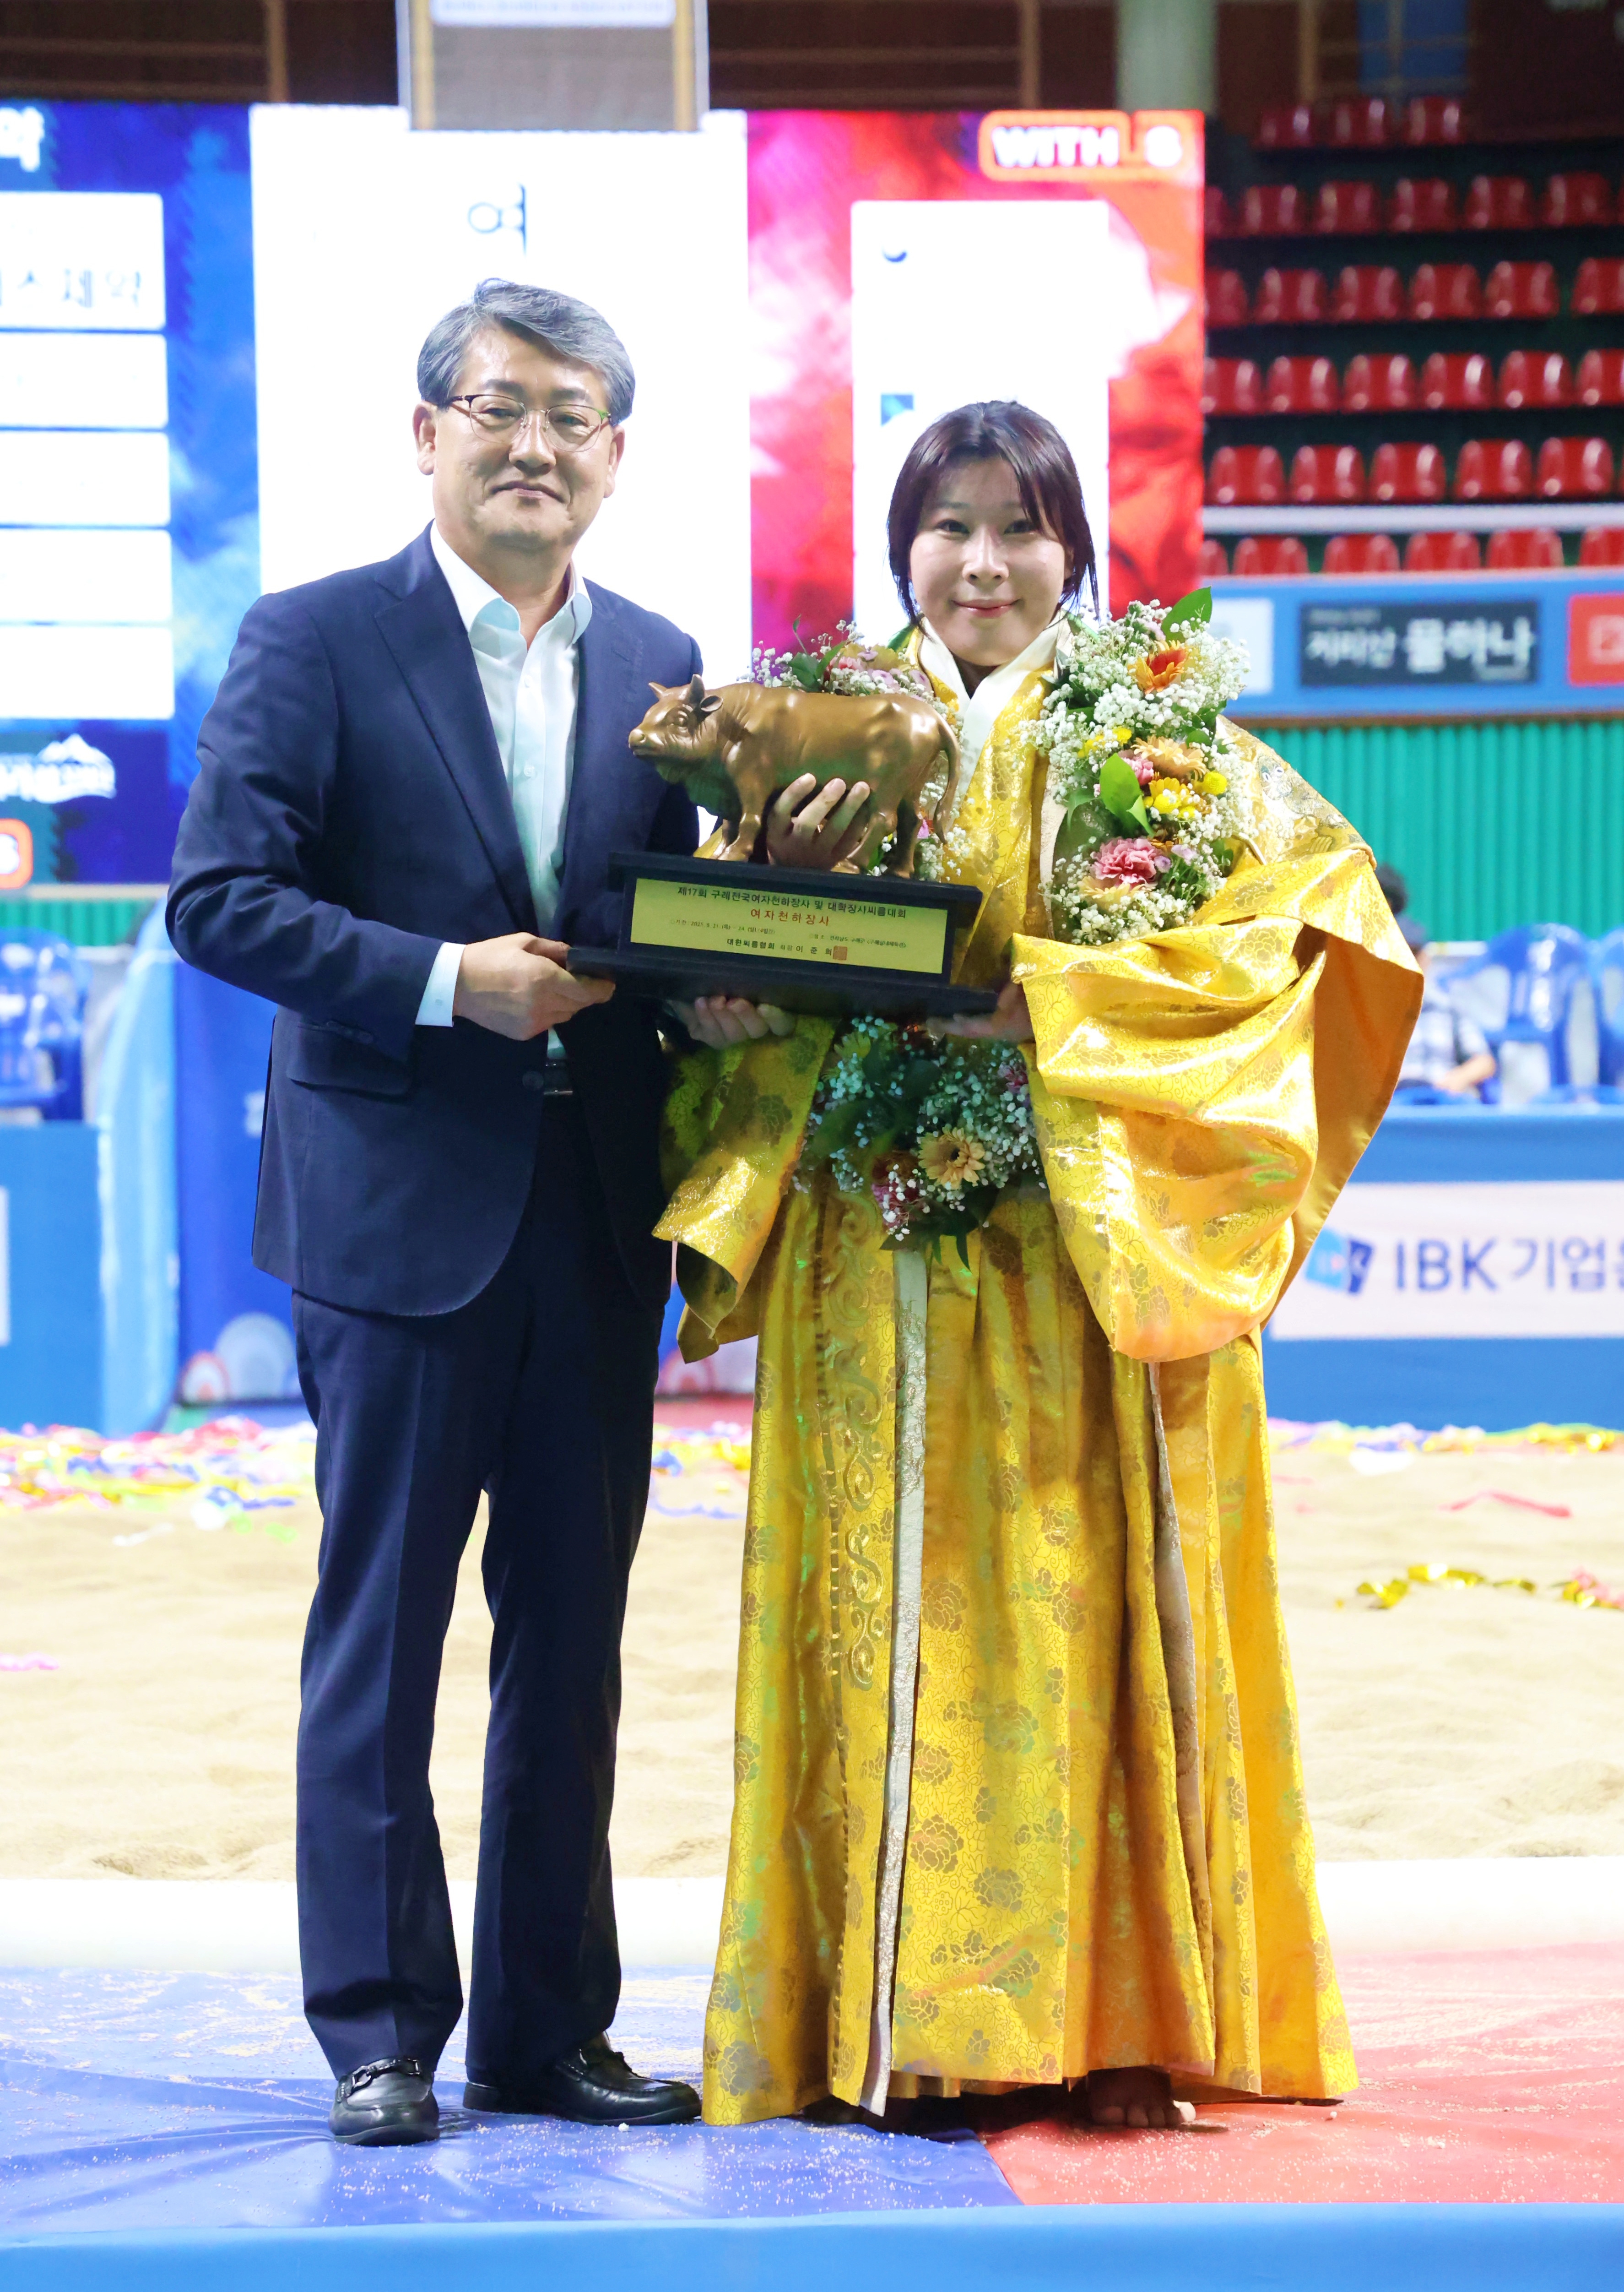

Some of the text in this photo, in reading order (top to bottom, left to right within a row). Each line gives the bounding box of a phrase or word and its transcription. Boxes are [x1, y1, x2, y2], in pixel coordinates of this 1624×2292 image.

[991, 125, 1120, 168] WITH
[677, 886, 707, 898] 제17회
[815, 901, 823, 910] 및
